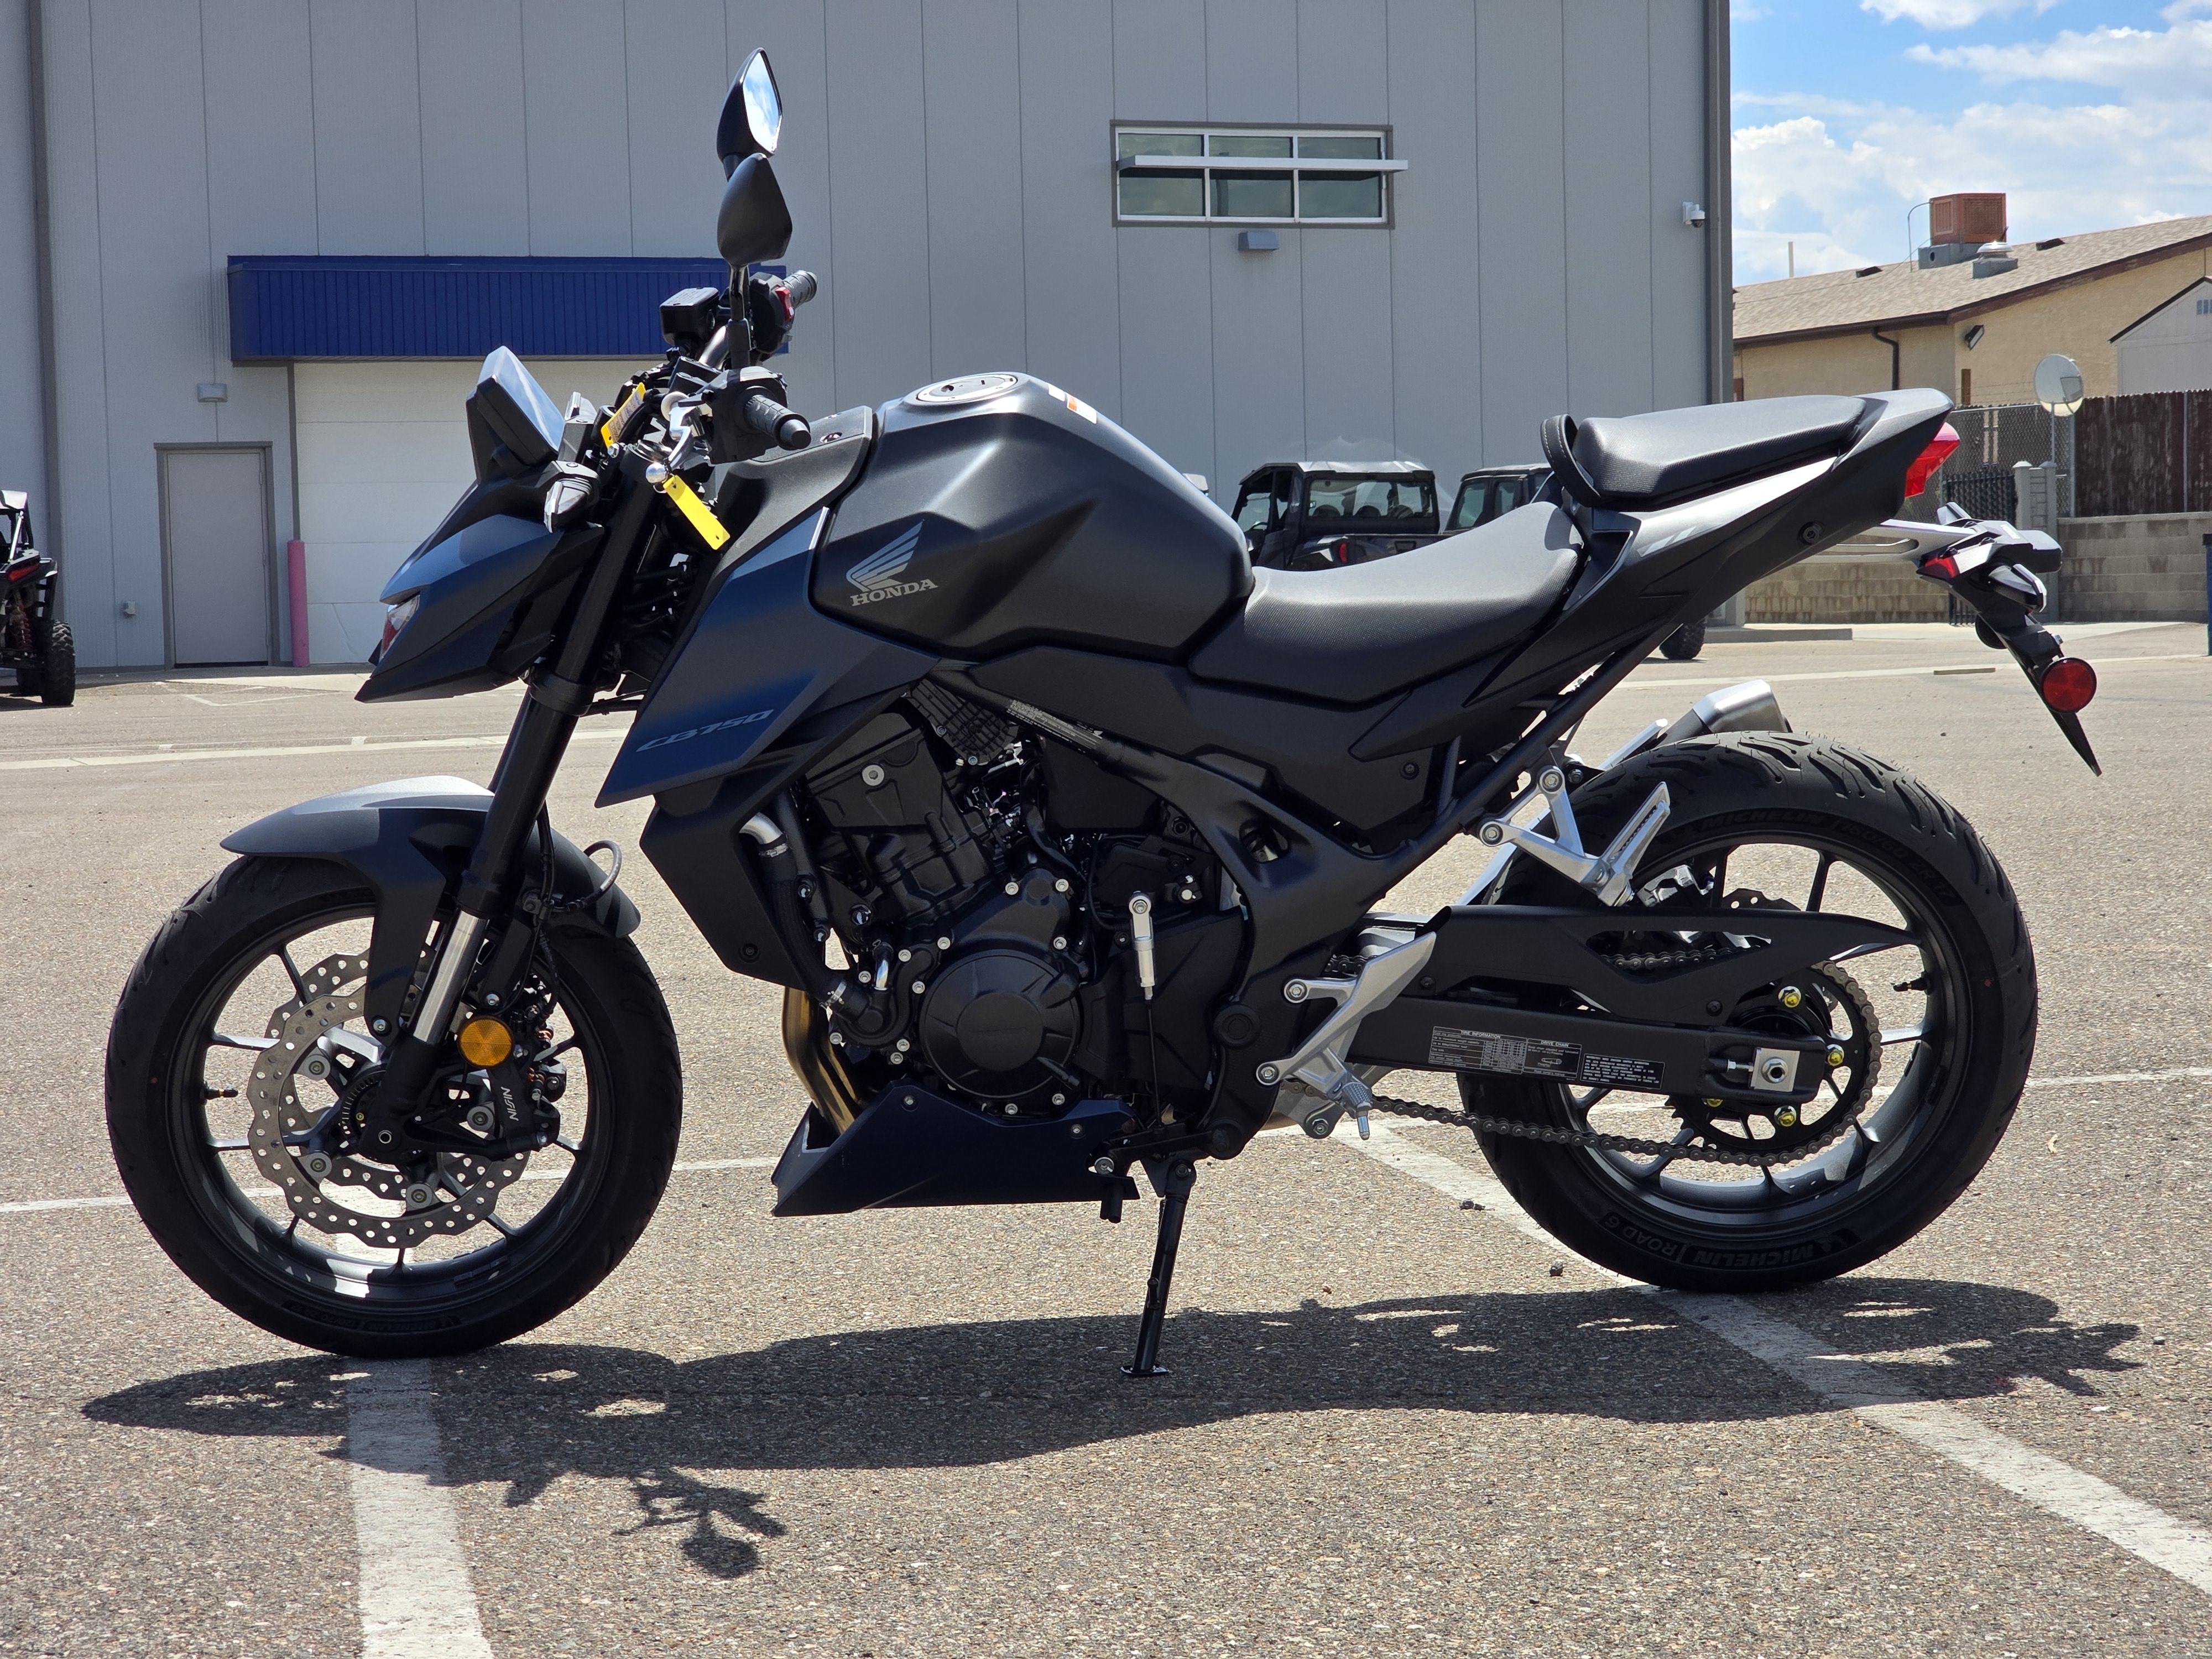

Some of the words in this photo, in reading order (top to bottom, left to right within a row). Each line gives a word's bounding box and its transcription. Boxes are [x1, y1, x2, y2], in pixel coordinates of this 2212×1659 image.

[851, 578, 938, 606] HONDA
[636, 709, 774, 752] CB750
[1702, 810, 1822, 832] MICHELIN
[1604, 1214, 1620, 1228] 6
[1623, 1225, 1678, 1256] ROAD
[1693, 1244, 1814, 1266] MICHELIN
